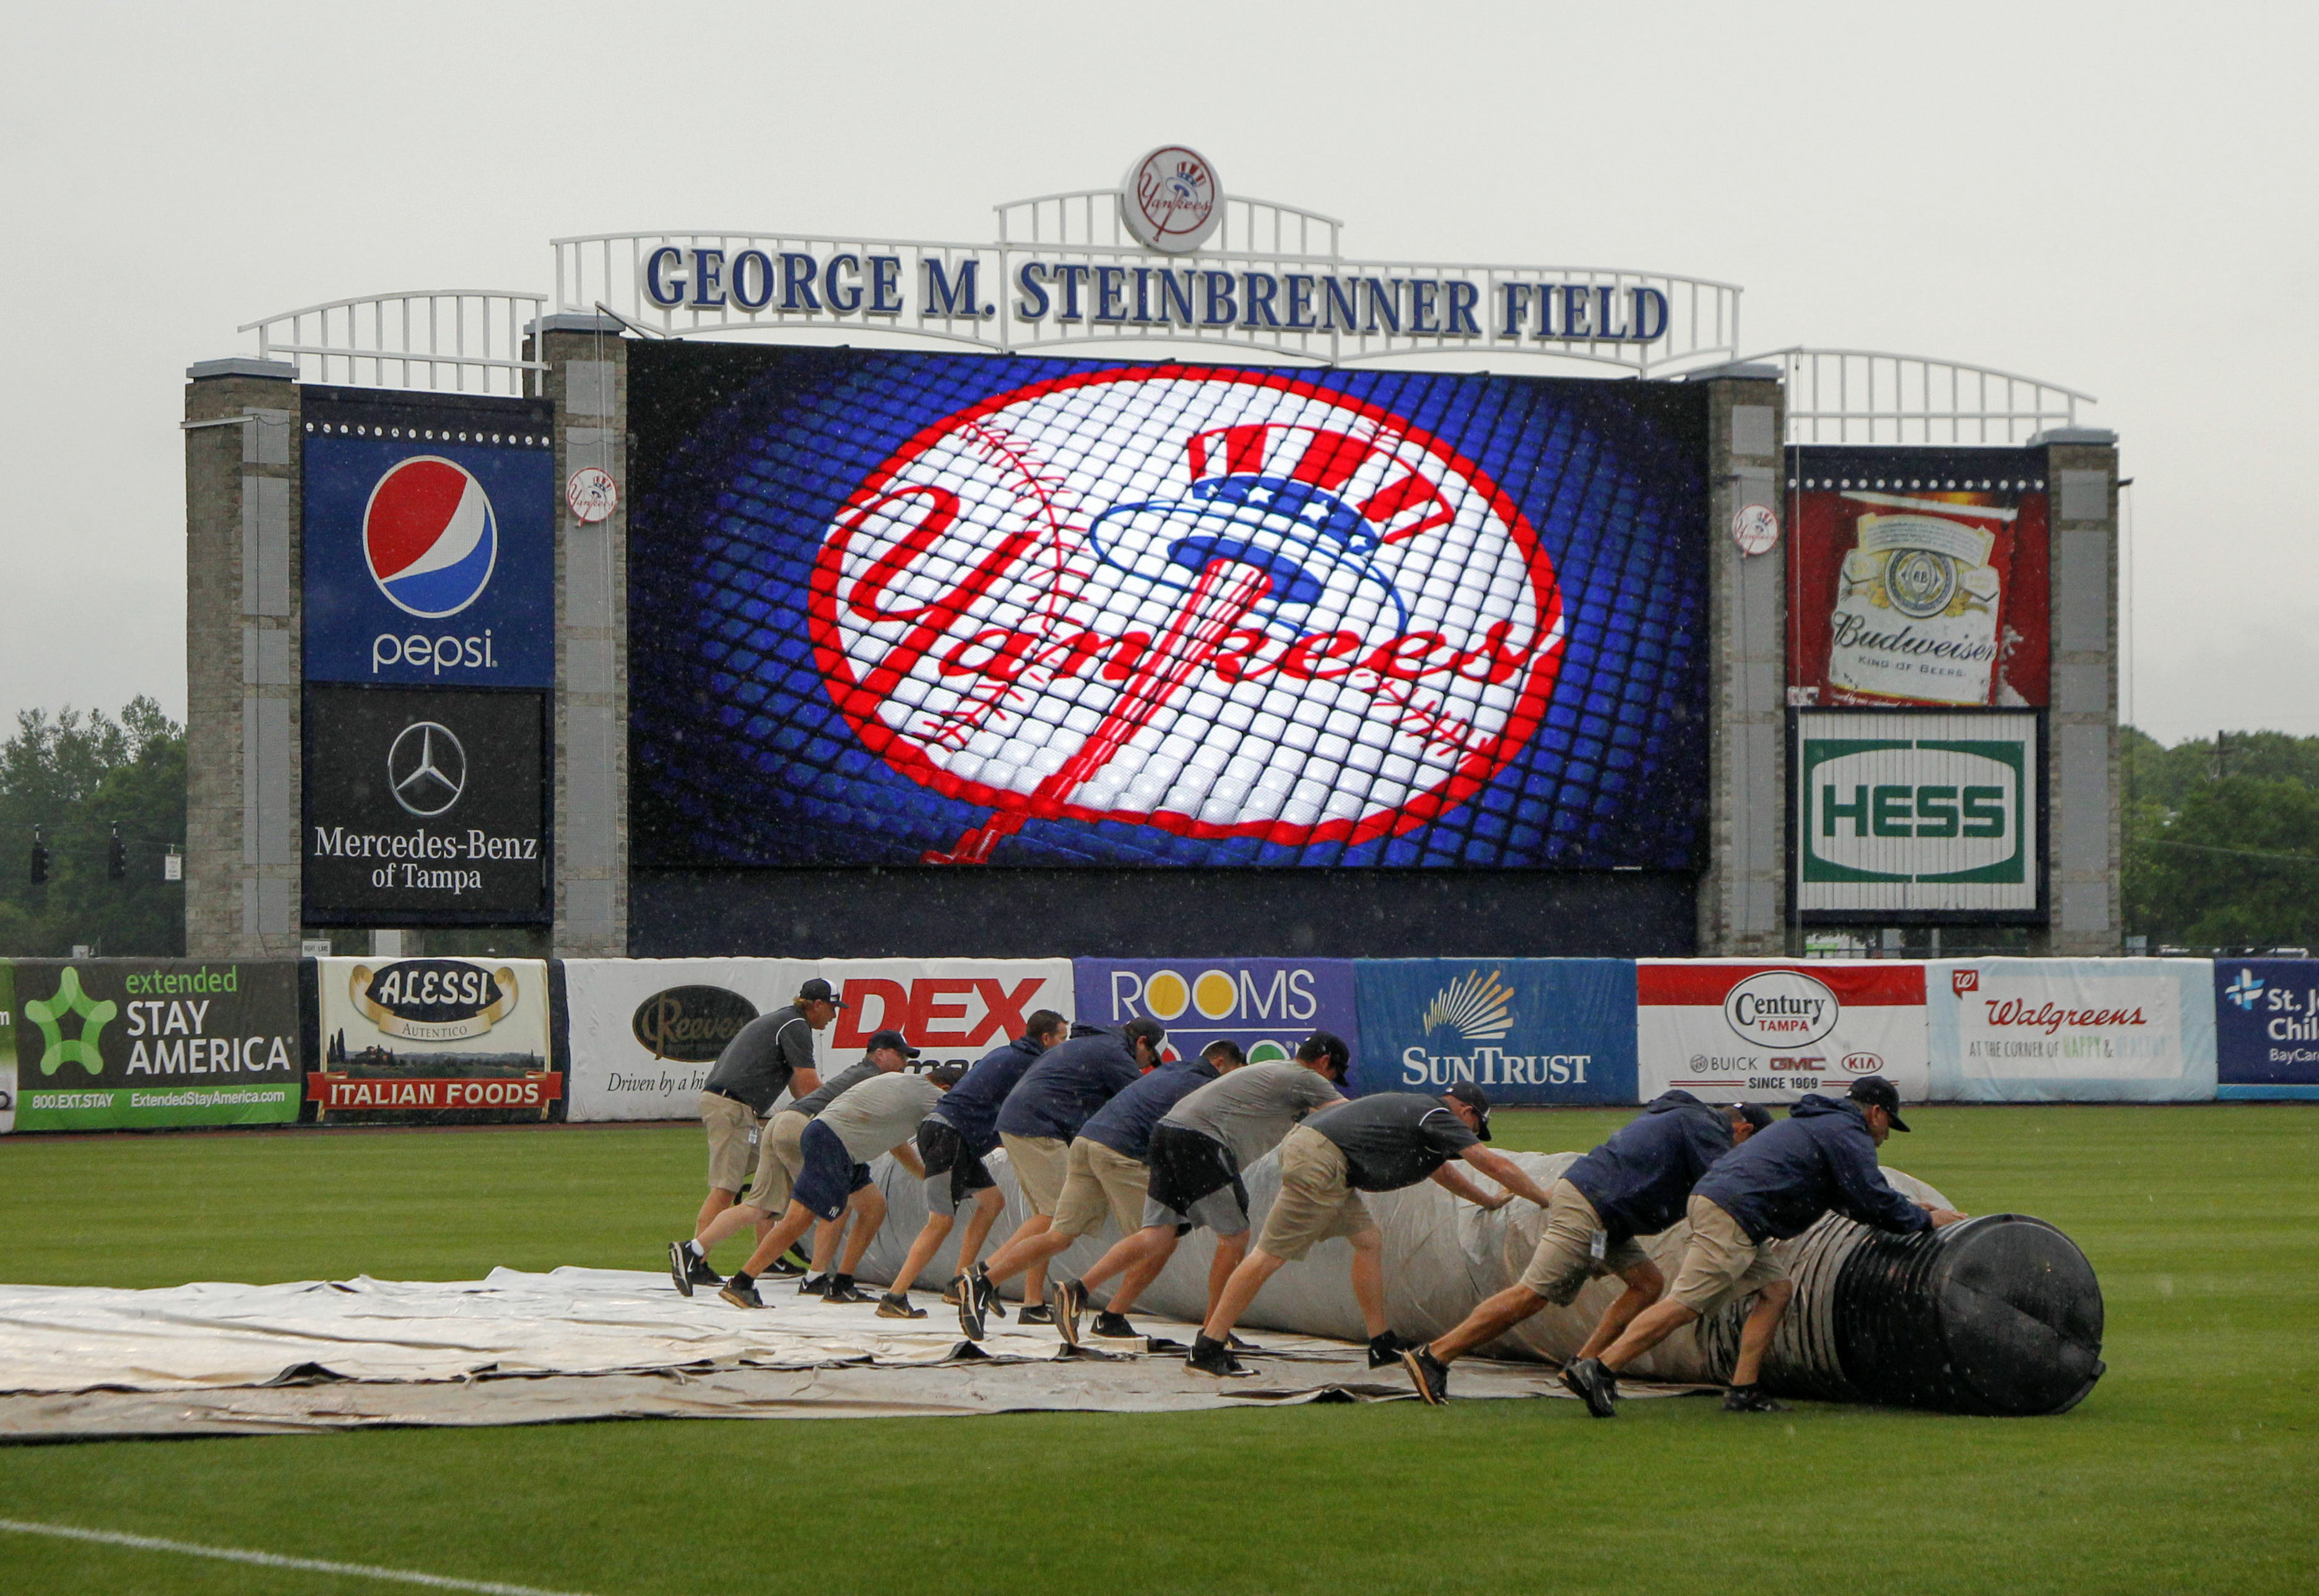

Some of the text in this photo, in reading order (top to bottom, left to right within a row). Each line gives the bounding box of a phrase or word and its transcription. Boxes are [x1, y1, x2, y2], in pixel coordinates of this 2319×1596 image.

[1139, 172, 1213, 212] Yankees
[646, 247, 1670, 344] GEORGE M. STEINBRENNER FIELD
[812, 484, 1565, 711] Yankees
[373, 628, 492, 675] pepsi
[1832, 612, 1998, 661] Budweiser
[1823, 784, 2006, 838] HESS
[314, 826, 538, 860] Mercedes-Benz
[371, 862, 482, 895] of Tampa
[126, 965, 238, 994] extended
[379, 971, 488, 1005] ALESSI
[1111, 969, 1317, 1021] ROOMS
[126, 1000, 210, 1036] STAY
[831, 978, 1046, 1048] DEX
[1735, 993, 1826, 1026] Century
[1985, 997, 2148, 1036] Walgreens
[2268, 988, 2319, 1017] St. J
[402, 1023, 468, 1037] AUTENTICO
[1759, 1020, 1809, 1032] TAMPA
[2268, 1017, 2319, 1041] Chil
[125, 1036, 292, 1075] AMERICA
[1970, 1041, 1981, 1057] AT
[1984, 1041, 2001, 1057] THE
[2004, 1041, 2044, 1057] CORNER
[2048, 1041, 2059, 1057] OF
[2063, 1036, 2101, 1058] HAPPY
[1712, 1056, 1876, 1072] BUICK GMC KIA
[131, 1090, 285, 1108] ExtendedStayAmerica.com
[329, 1083, 540, 1105] ITALIAN FOODS
[607, 1072, 655, 1092] Driven
[659, 1070, 675, 1098] by
[678, 1077, 687, 1090] a
[1749, 1077, 1818, 1090] SINCE 1969
